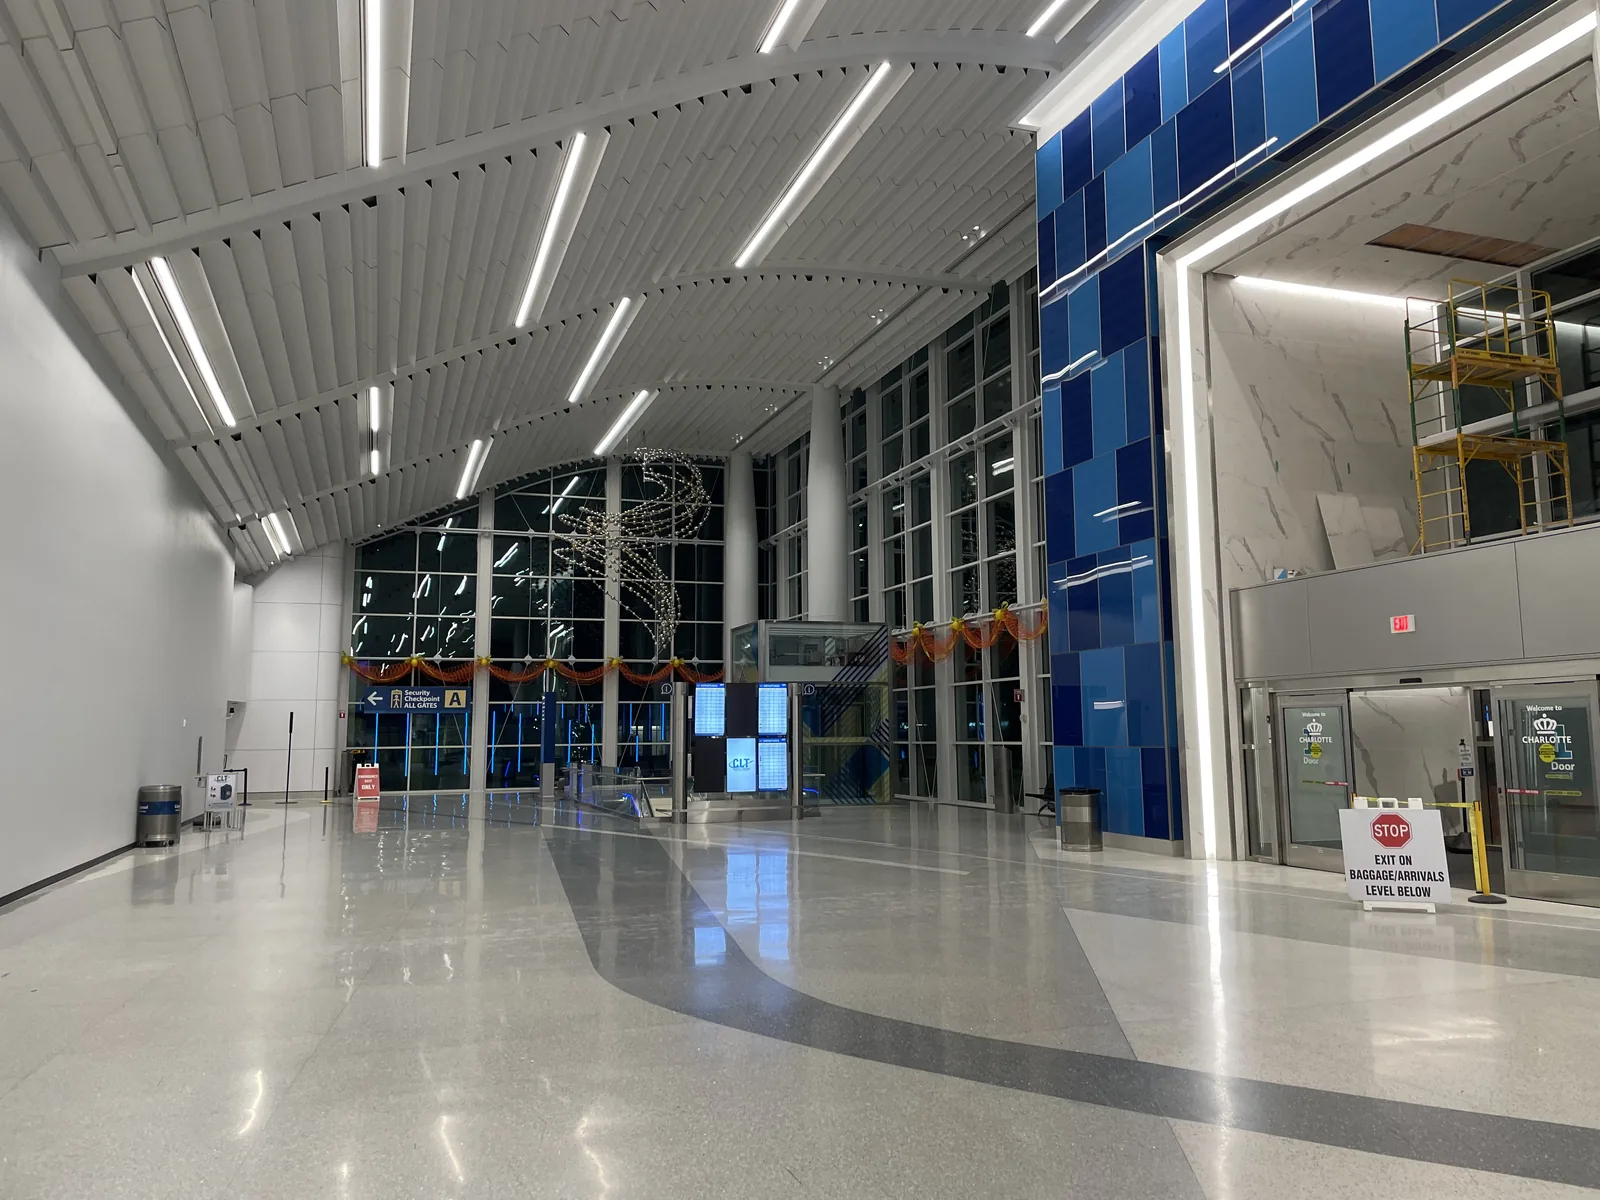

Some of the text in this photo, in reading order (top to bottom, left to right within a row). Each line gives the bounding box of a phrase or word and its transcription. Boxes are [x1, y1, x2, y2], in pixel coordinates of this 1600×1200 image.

[1393, 616, 1408, 631] EXIT
[448, 692, 462, 706] A
[1522, 736, 1572, 744] CHARLOTTE
[732, 758, 750, 768] CLT
[1551, 761, 1575, 771] Door
[1374, 824, 1409, 838] STOP
[1374, 854, 1412, 866] EXIT ON
[1349, 869, 1445, 882] BAGGAGE/ARRIVALS
[1365, 885, 1431, 898] LEVEL BELOW
